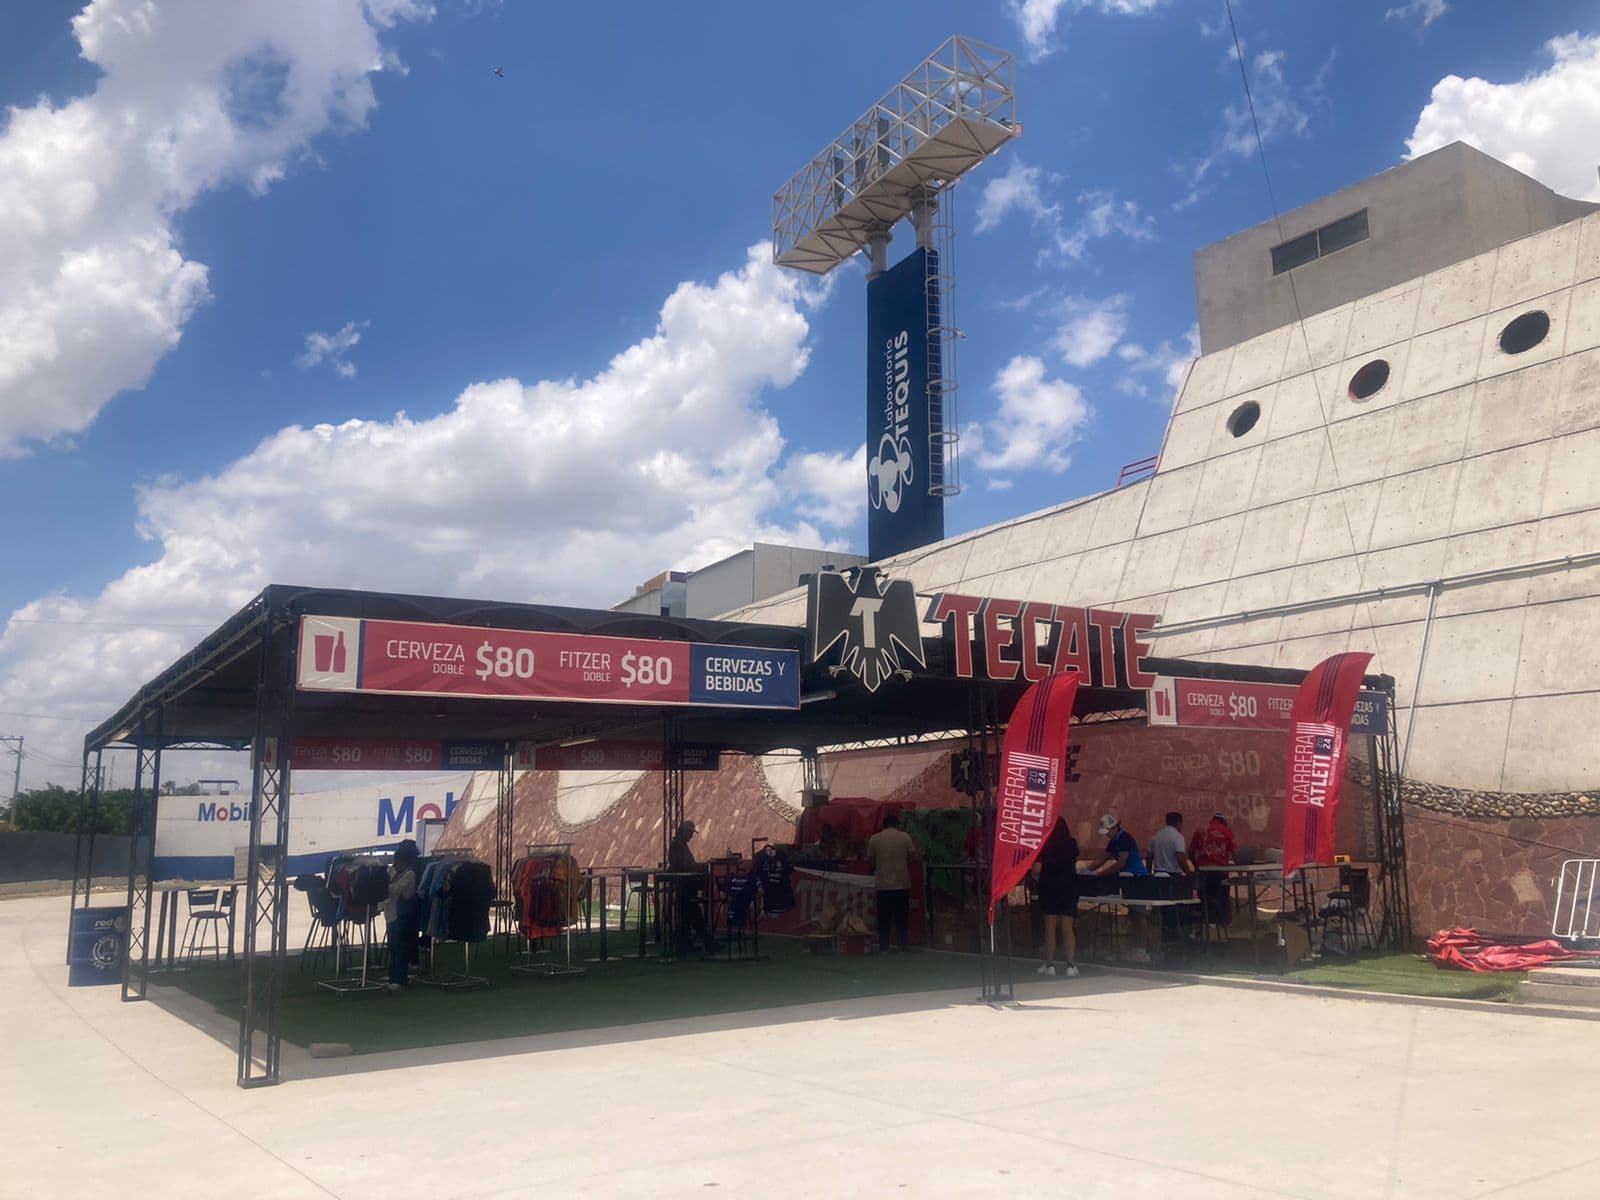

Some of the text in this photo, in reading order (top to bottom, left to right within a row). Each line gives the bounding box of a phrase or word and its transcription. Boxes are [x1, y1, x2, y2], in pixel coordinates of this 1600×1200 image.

[884, 339, 893, 430] Laboratorio
[894, 330, 910, 442] TEQUIS
[849, 597, 884, 648] T
[931, 592, 1158, 690] TECATE
[386, 639, 535, 681] CERVEZA $80
[432, 663, 465, 675] DOBLE
[559, 650, 673, 688] FITZER $80
[705, 656, 786, 677] CERVEZAS Y
[583, 671, 611, 682] DOBLE
[705, 674, 763, 693] BEBIDAS
[1186, 691, 1258, 720] CERVEZA $80
[1267, 697, 1294, 711] FITZER
[1374, 703, 1381, 714] Y
[332, 744, 361, 764] $80
[404, 744, 433, 765] $80
[1322, 738, 1332, 750] 24
[1028, 770, 1037, 784] 20
[1037, 772, 1047, 785] 24
[1216, 747, 1261, 781] $80
[1291, 735, 1315, 805] CARRERA
[1309, 754, 1331, 808] ATLETI
[198, 801, 253, 822] Mobil
[999, 767, 1026, 844] CARRERA
[1019, 790, 1047, 850] ATLETI
[1224, 790, 1266, 824] $80
